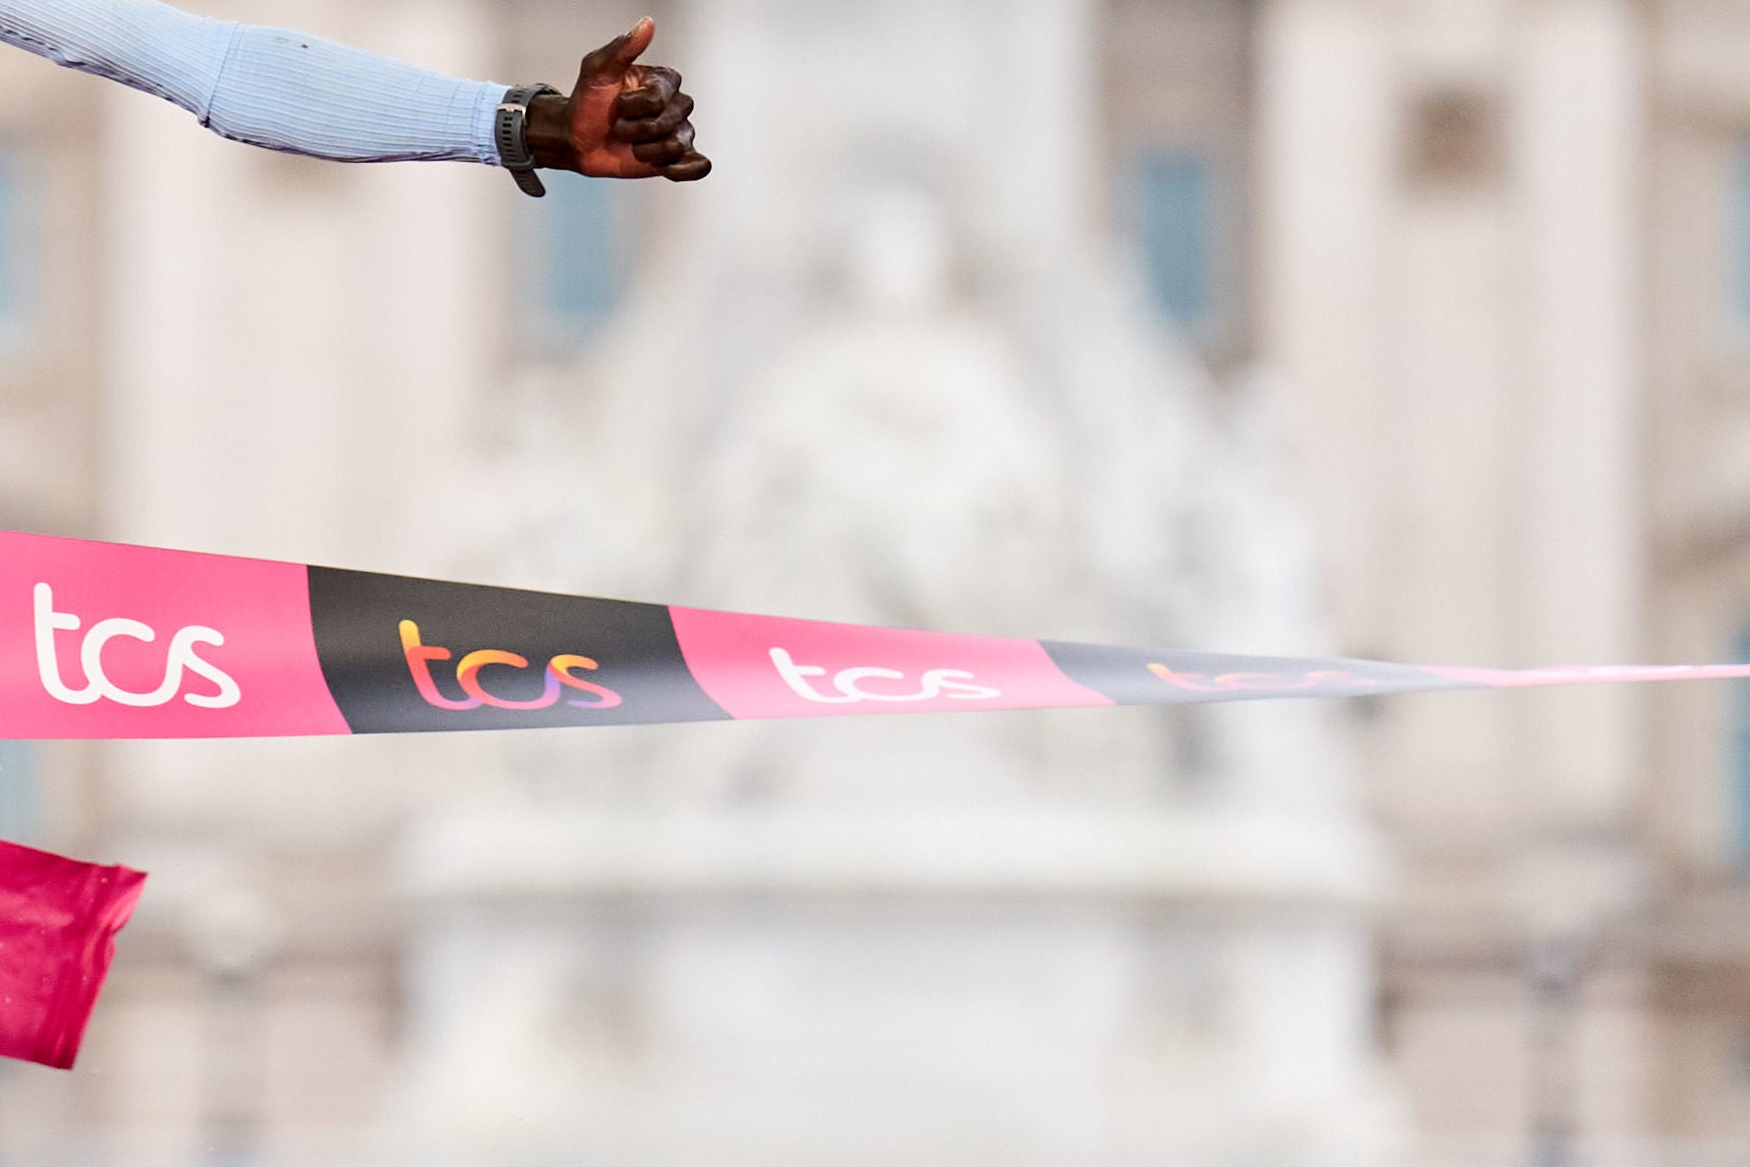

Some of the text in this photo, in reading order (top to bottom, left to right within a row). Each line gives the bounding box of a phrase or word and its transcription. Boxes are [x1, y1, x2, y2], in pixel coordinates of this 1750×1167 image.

[34, 581, 241, 709] tcs
[398, 619, 623, 711] tcs
[769, 647, 1002, 703] tcs
